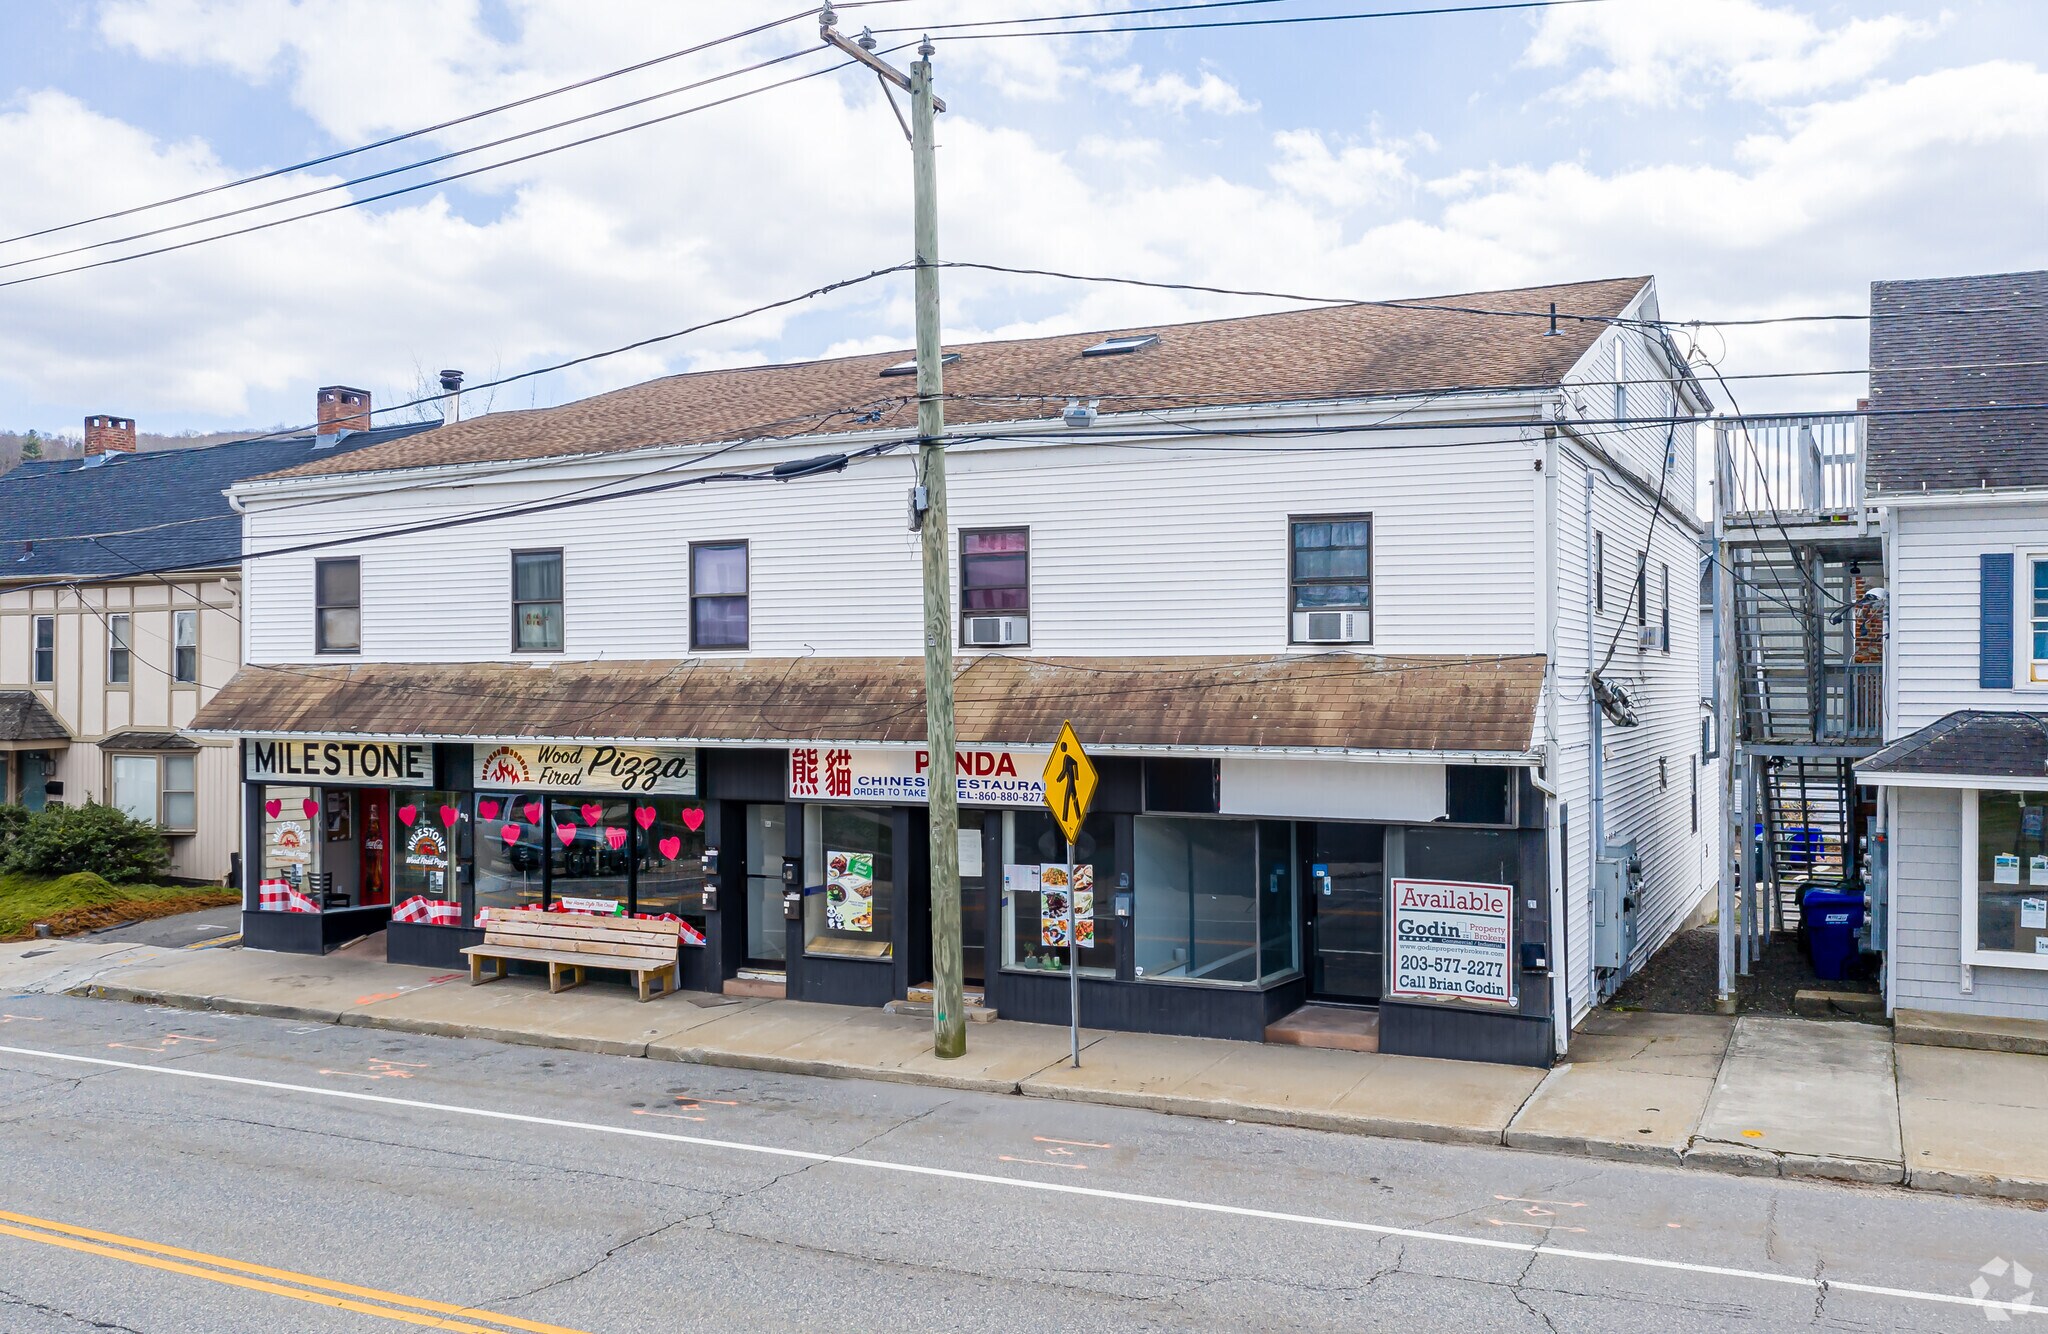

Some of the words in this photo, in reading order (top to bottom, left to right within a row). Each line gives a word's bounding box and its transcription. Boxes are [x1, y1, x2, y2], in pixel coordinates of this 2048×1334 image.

[255, 742, 424, 778] MILESTONE
[538, 745, 583, 764] Wood
[915, 750, 1018, 777] PNDA
[538, 766, 583, 786] Fired
[587, 745, 689, 792] Pizza
[792, 748, 852, 797] 熊貓
[853, 787, 885, 796] ORDER
[887, 788, 900, 797] TO
[902, 788, 926, 797] TAKE
[857, 776, 930, 787] CHINES
[957, 779, 1046, 791] ESTAURA
[272, 821, 307, 846] MILESTONE
[407, 827, 447, 853] MILESTONE
[1401, 887, 1504, 913] Available
[1398, 919, 1461, 938] Godin
[1470, 923, 1506, 935] Property
[1474, 932, 1506, 943] Brokers
[1400, 944, 1505, 957] www.godinpropertybrokers.com
[1401, 955, 1503, 978] 203-577-2277
[1399, 974, 1426, 989] Call
[1428, 976, 1463, 992] Brian
[1465, 979, 1505, 996] Godin
